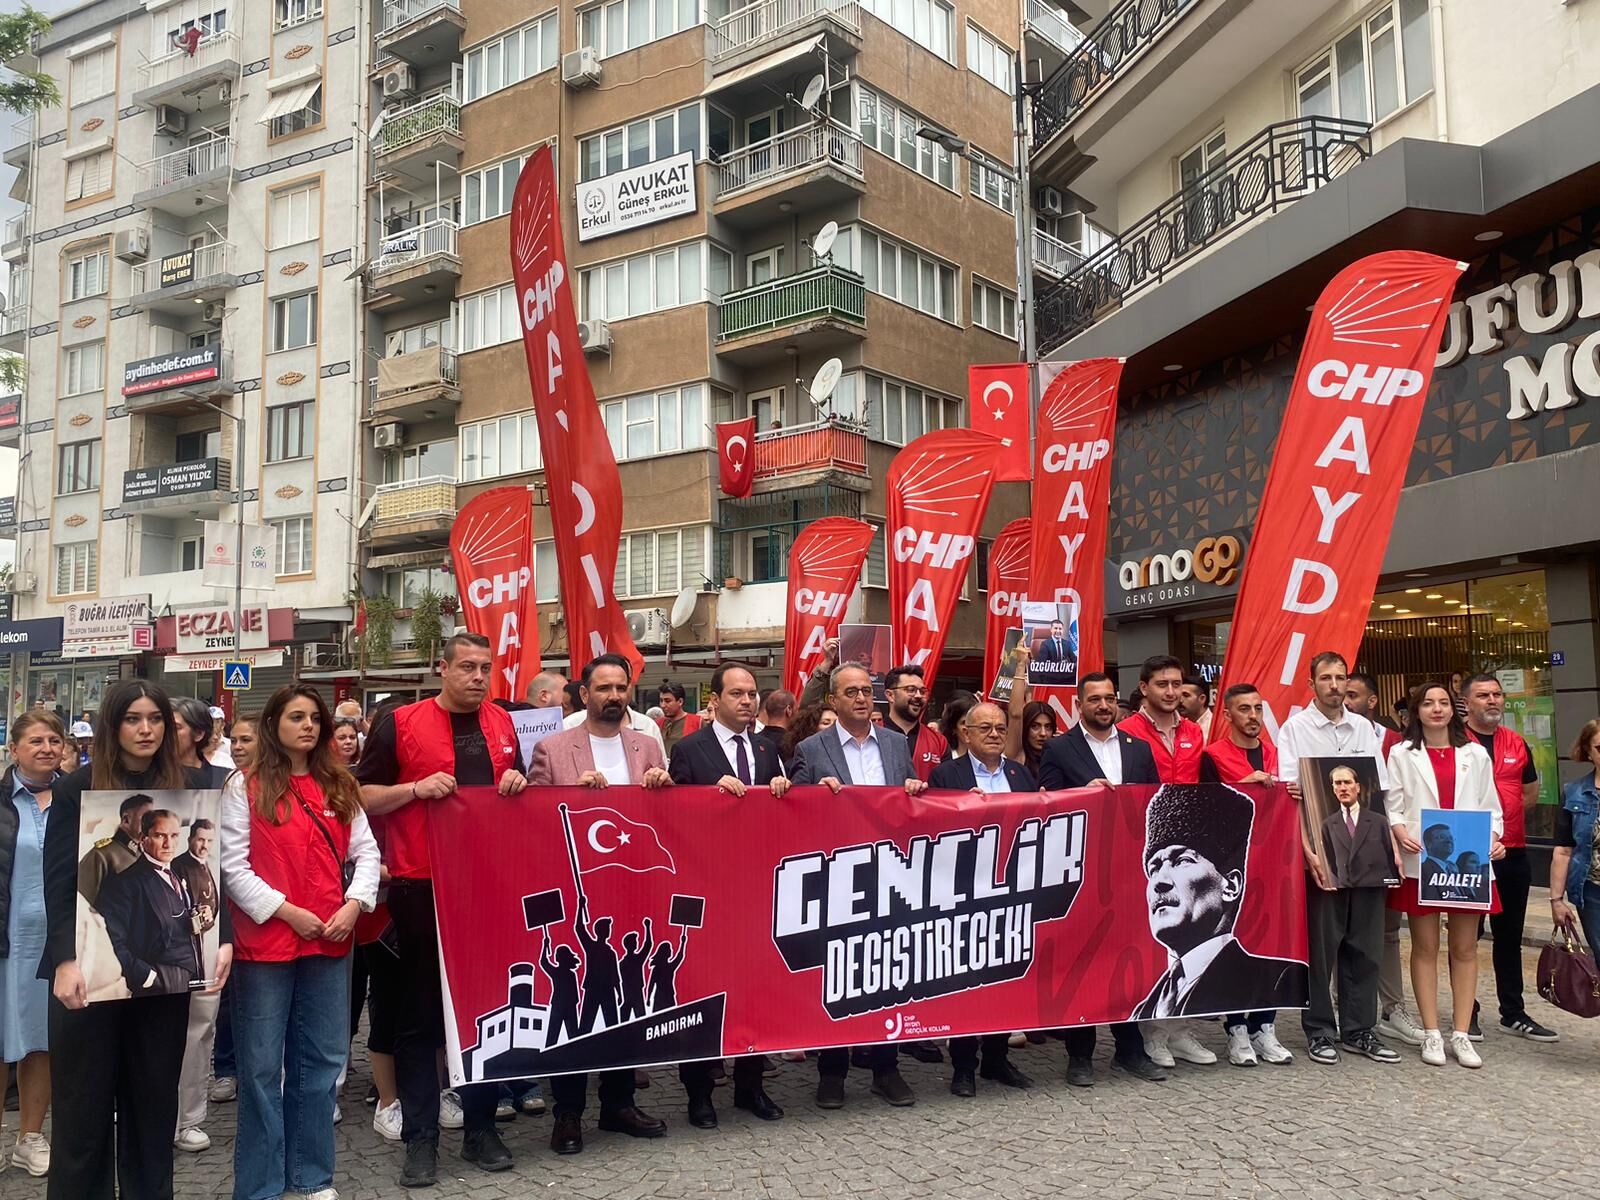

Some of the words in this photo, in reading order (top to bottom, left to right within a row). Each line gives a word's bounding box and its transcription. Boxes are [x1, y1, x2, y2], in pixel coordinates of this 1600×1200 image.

[618, 163, 689, 199] AVUKAT
[618, 195, 650, 212] Güneş
[654, 184, 690, 202] ERKUL
[581, 211, 611, 229] Erkul
[162, 253, 192, 272] AVUKAT
[523, 260, 565, 331] CHP
[126, 350, 214, 381] aydinhedef.com.tr
[1307, 358, 1424, 406] CHP
[1043, 439, 1110, 473] CHP
[161, 473, 188, 485] OSMAN
[189, 470, 212, 482] YILDIZ
[894, 526, 975, 569] CHP
[468, 566, 531, 609] CHP
[1125, 593, 1154, 606] GENÇ
[1159, 585, 1195, 600] ODASI
[79, 603, 107, 622] BUĞRA
[989, 590, 1028, 617] CH
[178, 608, 262, 637] ECZANE
[189, 658, 218, 669] ZEYNEP
[1030, 660, 1075, 673] ÖZGÜRLÜK!
[1428, 872, 1482, 888] ADALET!
[646, 1011, 703, 1041] BANDIRMA
